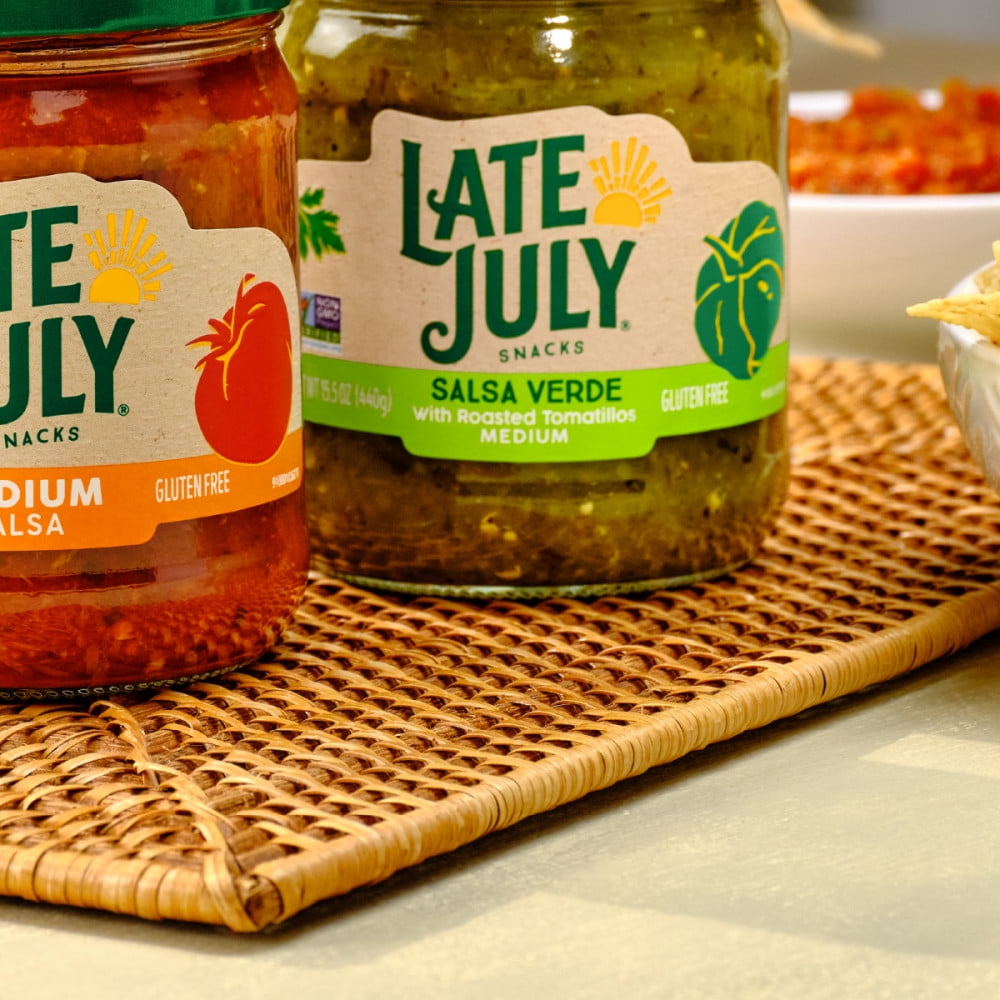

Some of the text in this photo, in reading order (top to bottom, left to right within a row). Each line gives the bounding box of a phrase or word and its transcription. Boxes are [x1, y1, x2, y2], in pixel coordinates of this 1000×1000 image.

[400, 134, 587, 266] LATE
[420, 237, 637, 364] JULY
[499, 340, 585, 363] SNACKS
[431, 377, 622, 404] SALSA VERDE
[661, 385, 704, 412] GLUTEN
[704, 380, 729, 406] FREE
[412, 406, 637, 426] With Roasted Tomatillos
[480, 428, 569, 444] MEDIUM
[155, 469, 231, 503] GLUTEN FREE
